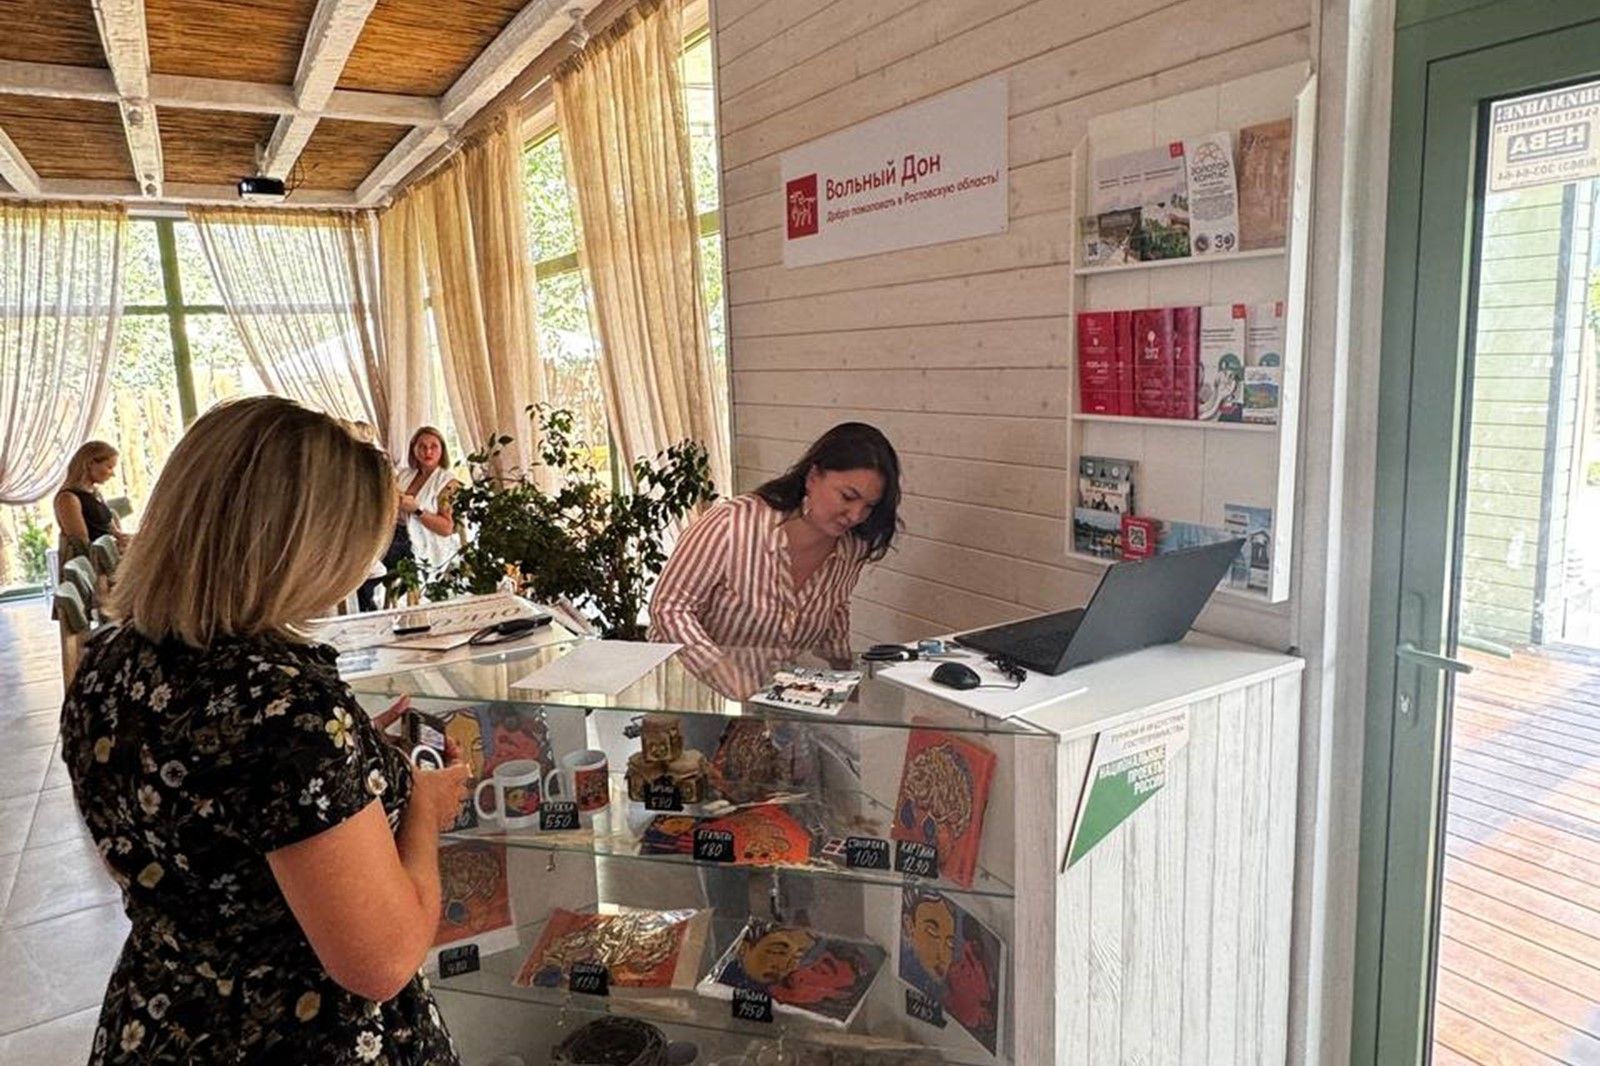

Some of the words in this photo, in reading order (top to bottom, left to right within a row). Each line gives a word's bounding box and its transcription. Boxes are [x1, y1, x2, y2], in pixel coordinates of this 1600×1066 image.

[826, 160, 897, 201] Вольный
[901, 153, 941, 187] Дон
[826, 208, 850, 224] Добро
[851, 199, 896, 219] пожаловать
[904, 185, 955, 206] Ростовскую
[956, 169, 1000, 193] область!
[854, 849, 879, 868] 100
